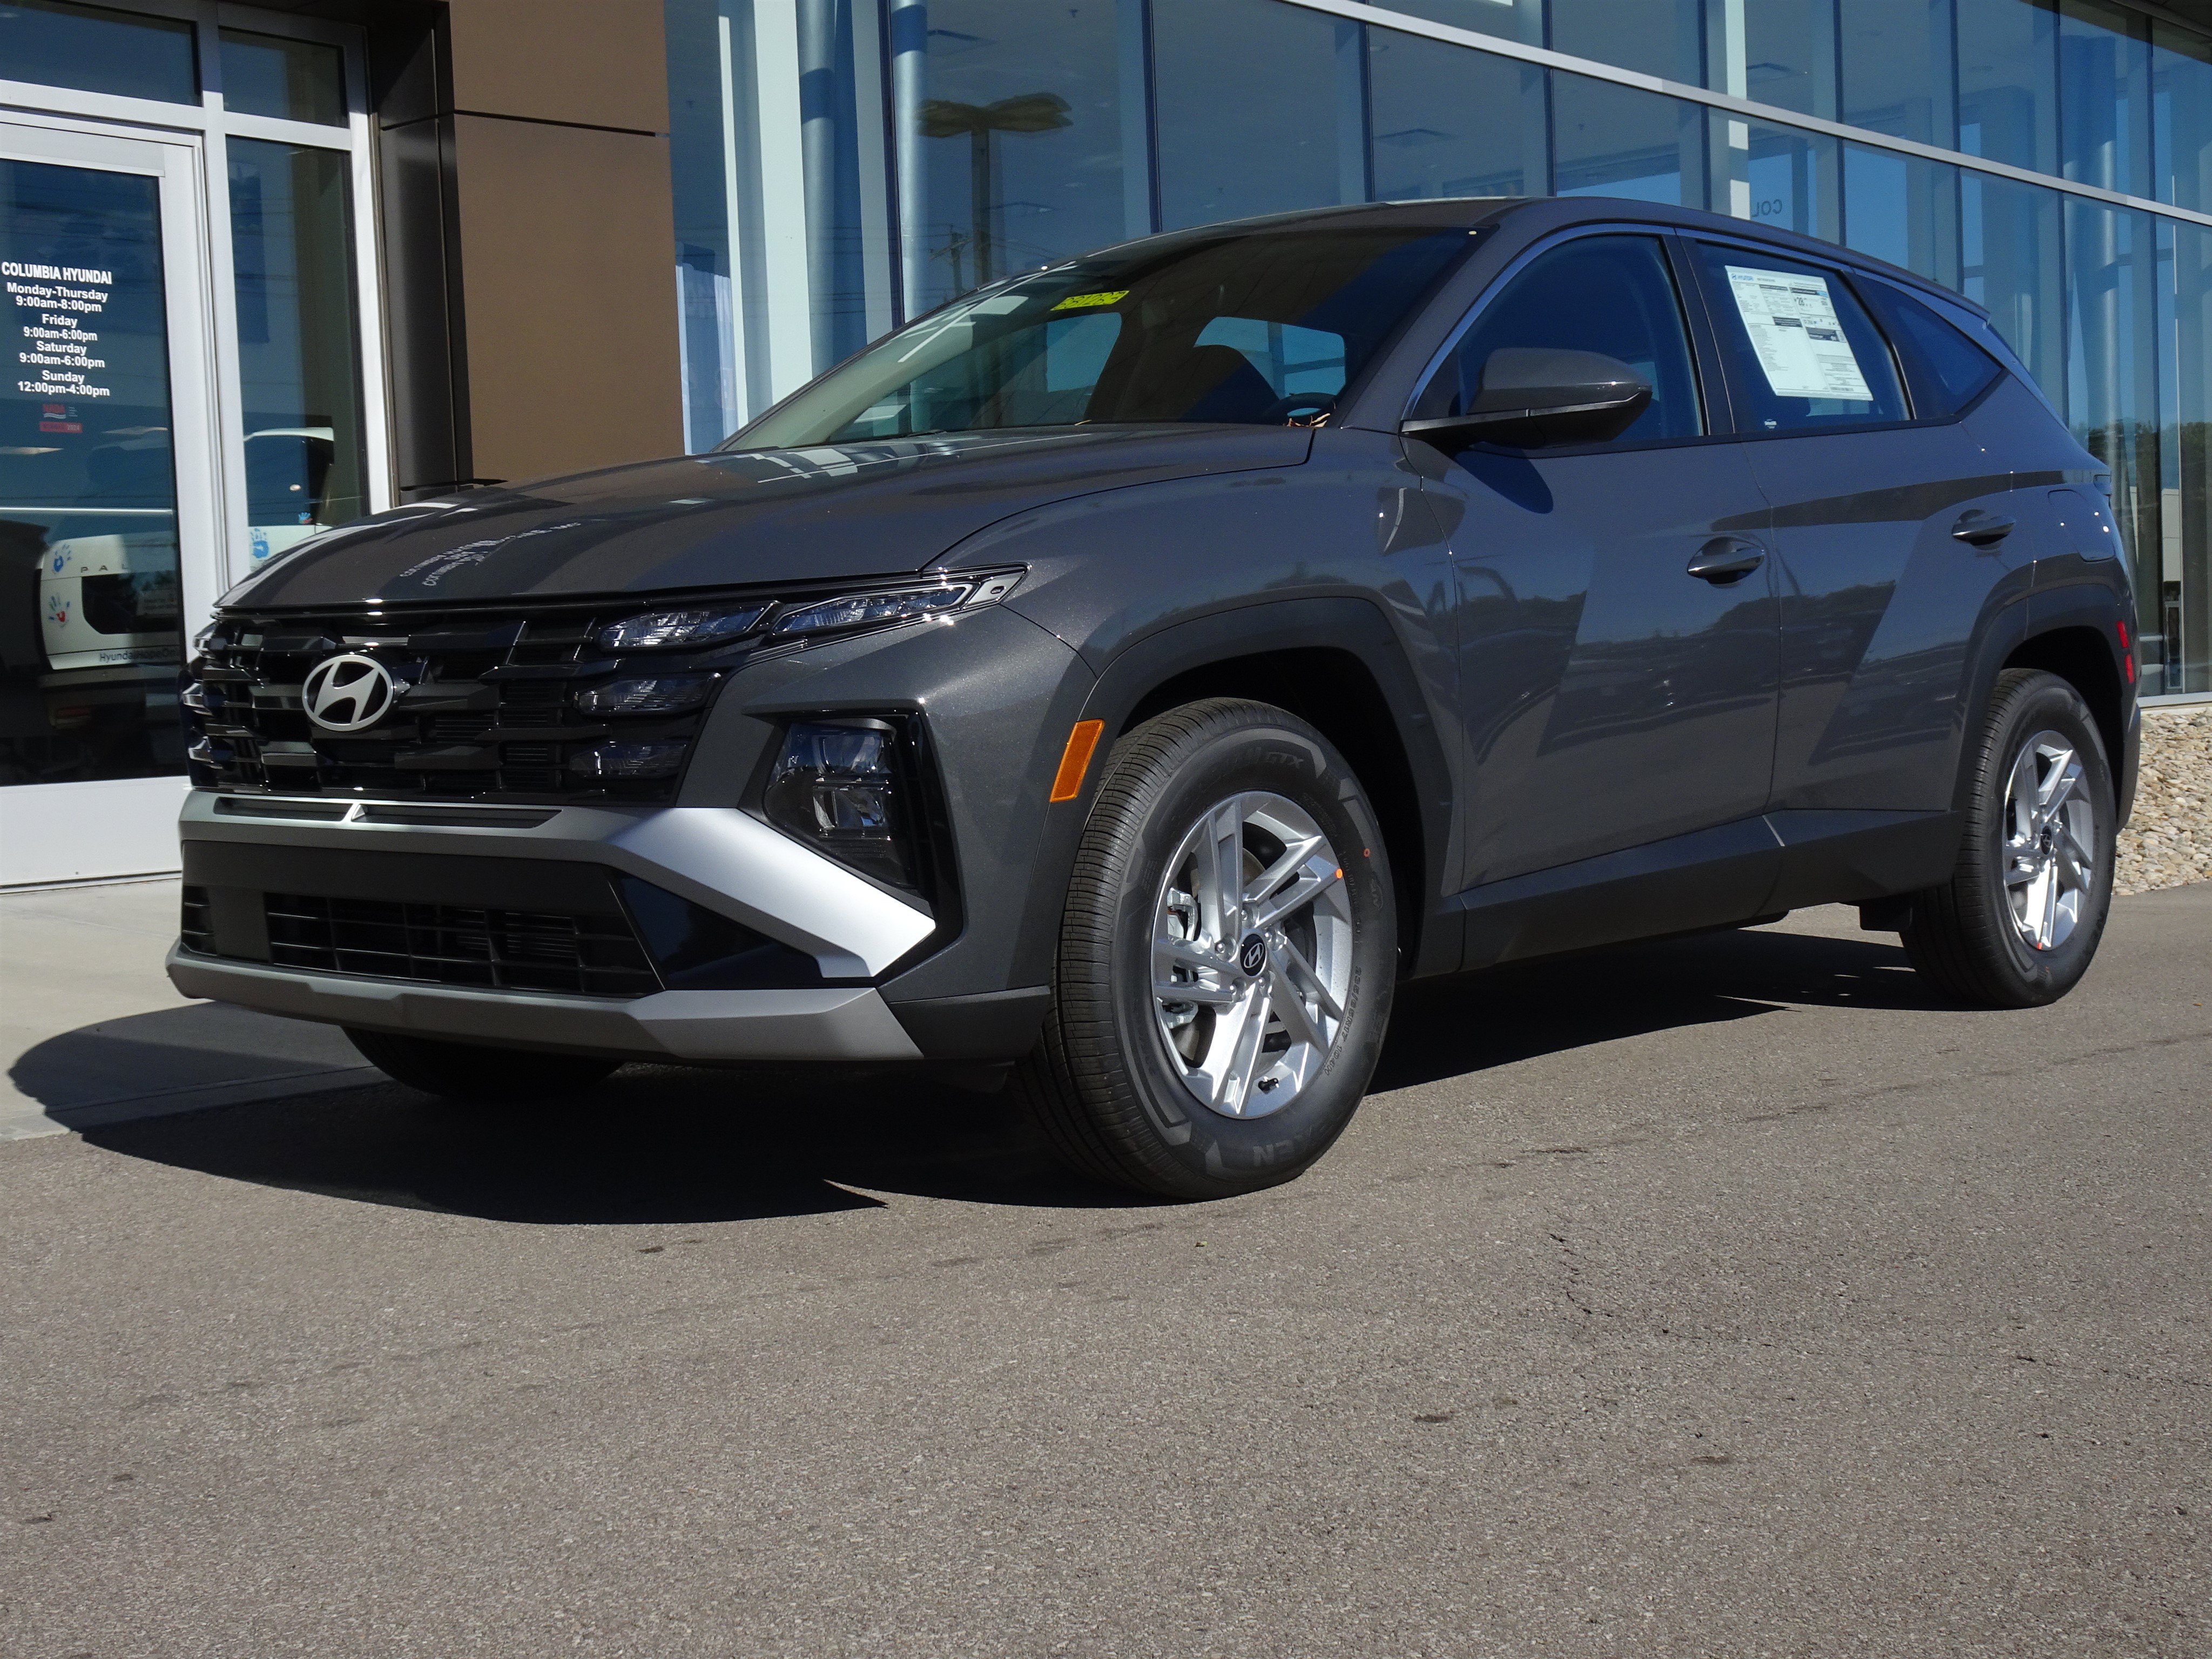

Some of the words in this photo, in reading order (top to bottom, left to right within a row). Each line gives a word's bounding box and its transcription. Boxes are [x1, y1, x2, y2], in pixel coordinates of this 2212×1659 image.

[2, 261, 62, 280] COLUMBIA
[63, 267, 112, 285] HYUNDAI
[7, 281, 108, 303] Monday-Thursday
[16, 295, 102, 313] 9:00am-8:00pm
[42, 313, 78, 328] Friday
[23, 326, 98, 342] 9:00am-6:00pm
[36, 340, 87, 356] Saturday
[19, 352, 105, 369] 9:00am-6:00pm
[42, 370, 85, 384] Sunday
[17, 381, 110, 397] 12:00pm-4:00pm
